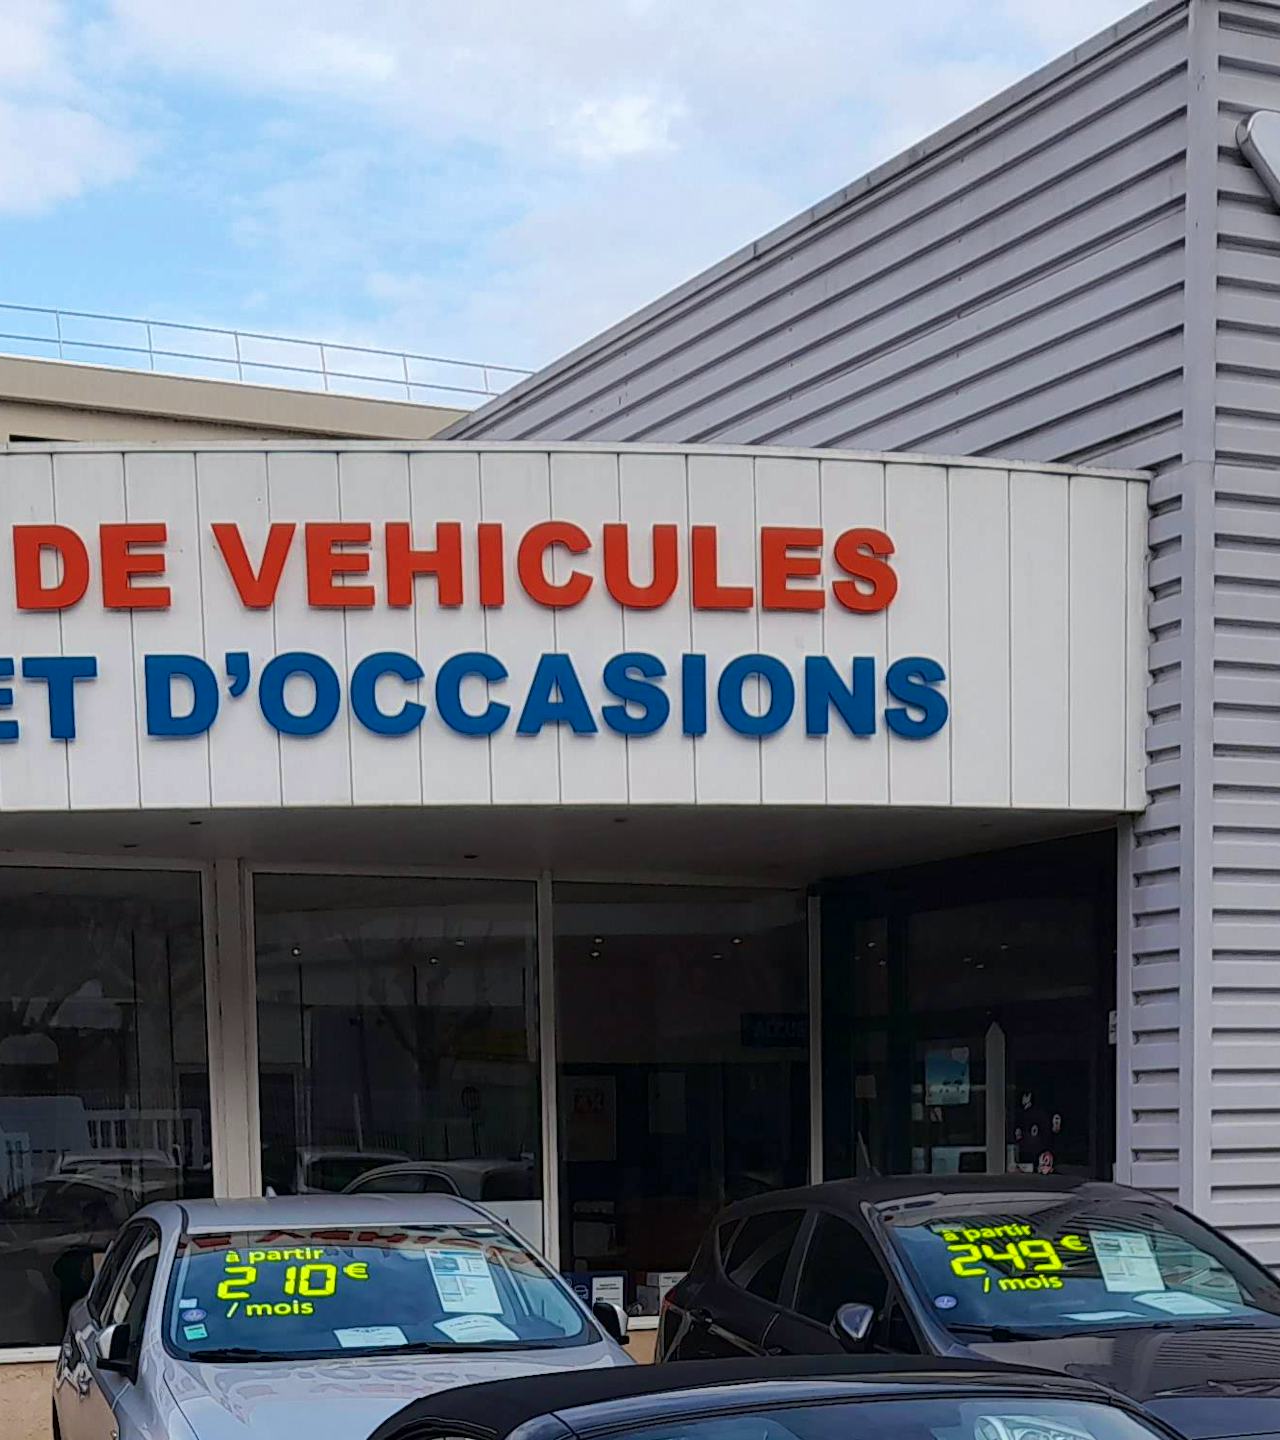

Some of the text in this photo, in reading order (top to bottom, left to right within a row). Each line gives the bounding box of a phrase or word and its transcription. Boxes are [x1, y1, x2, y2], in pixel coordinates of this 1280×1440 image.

[13, 522, 171, 611] DE
[210, 519, 899, 615] VEHICULES
[143, 651, 950, 741] D'OCCASIONS
[962, 1223, 1031, 1243] partir
[248, 1247, 324, 1265] partir
[997, 1273, 1064, 1291] mois
[245, 1299, 314, 1317] mois
